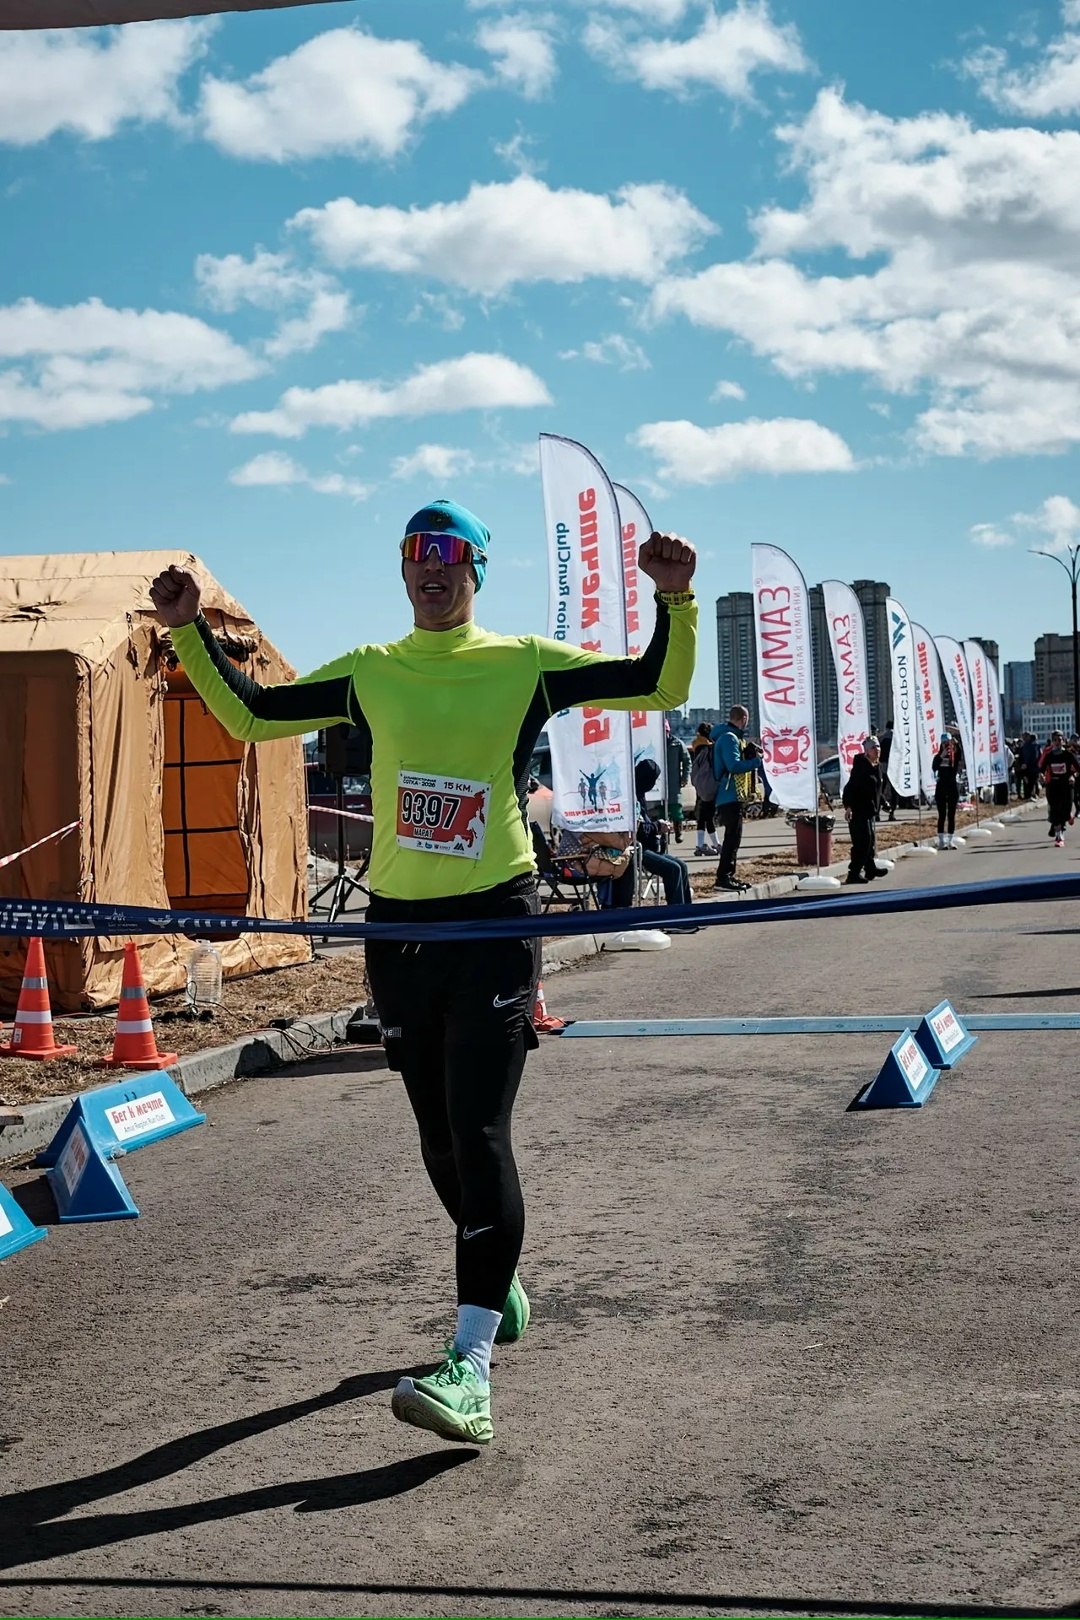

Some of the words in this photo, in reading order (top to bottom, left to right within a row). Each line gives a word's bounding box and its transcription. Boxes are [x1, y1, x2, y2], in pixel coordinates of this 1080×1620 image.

[758, 586, 796, 706] АЛМАЗ
[832, 614, 855, 716] АЛМАЗ
[444, 782, 454, 790] 15
[402, 791, 461, 829] 9397
[111, 1110, 128, 1124] Бег
[135, 1098, 164, 1117] мечте
